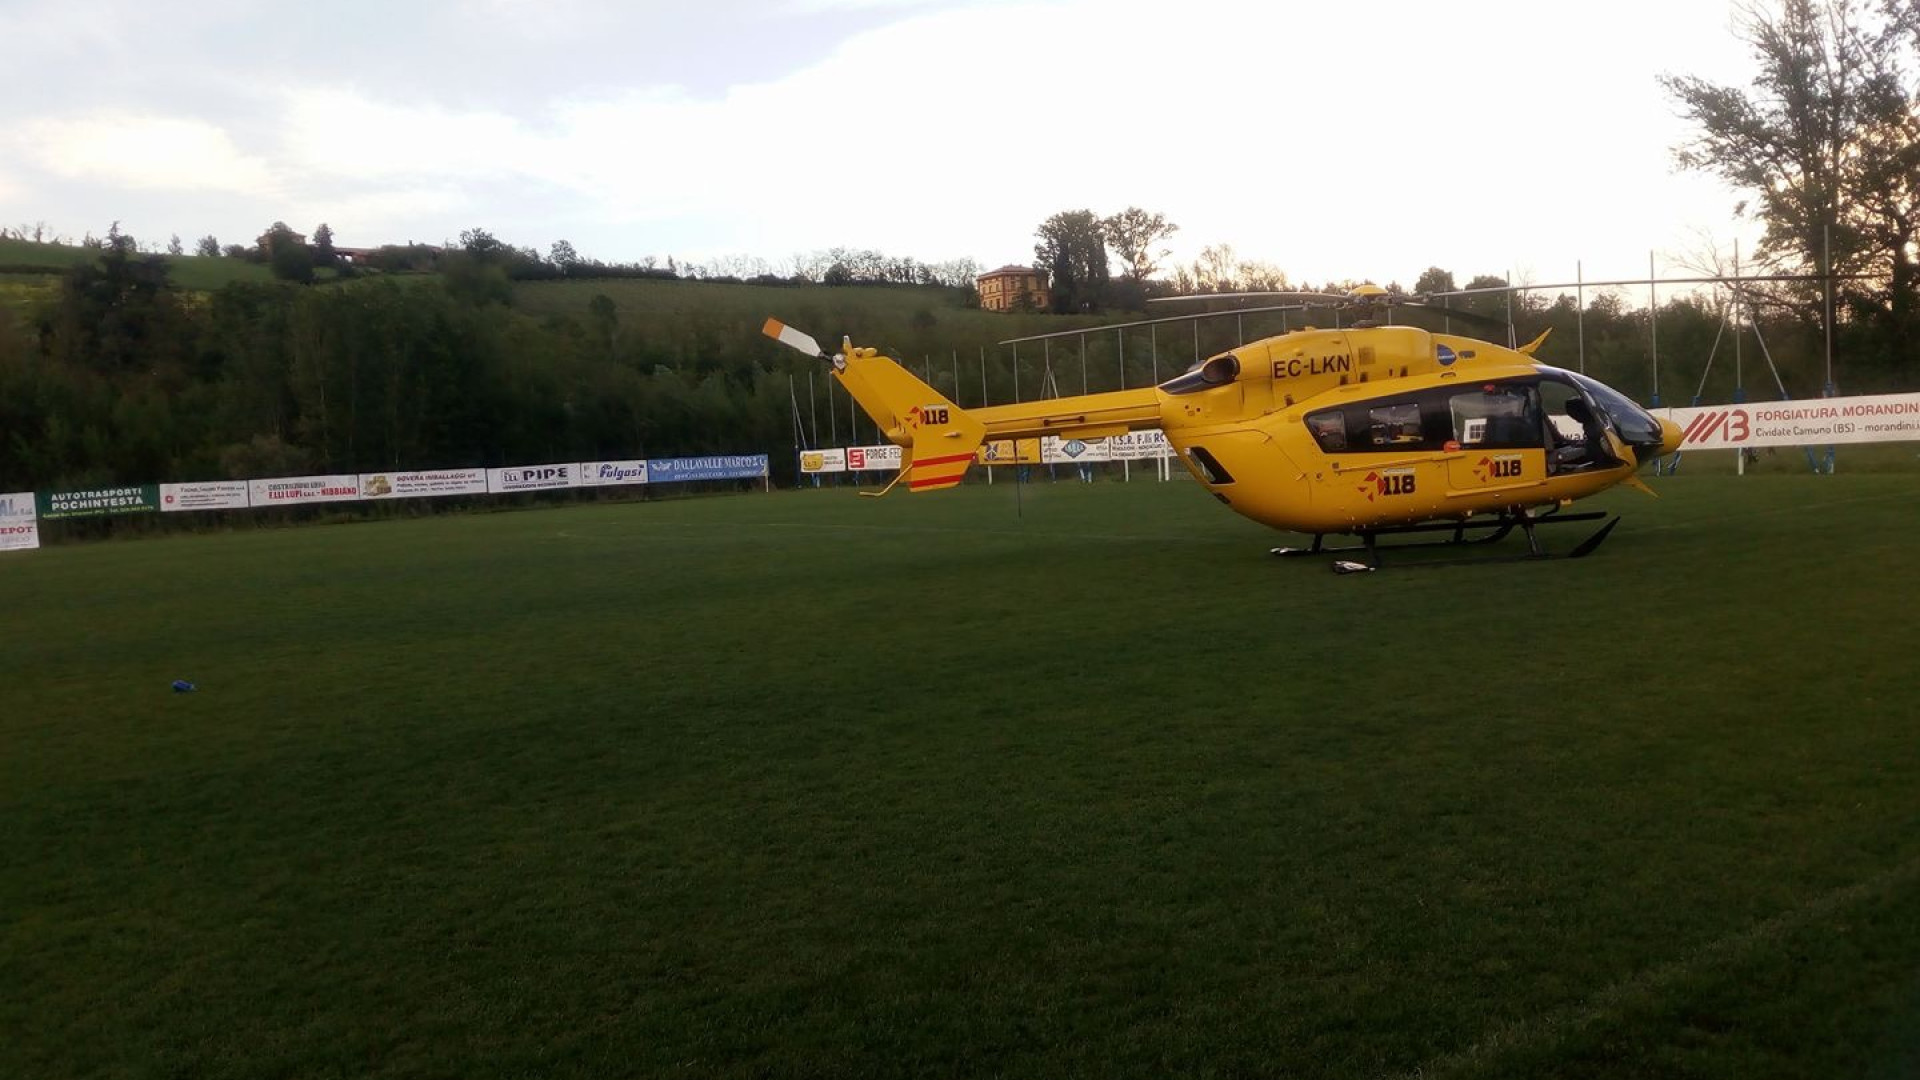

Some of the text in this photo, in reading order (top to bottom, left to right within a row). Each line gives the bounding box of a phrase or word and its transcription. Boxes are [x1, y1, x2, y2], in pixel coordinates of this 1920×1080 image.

[1273, 354, 1351, 379] EC-LKN
[924, 409, 949, 424] 118
[1755, 408, 1838, 421] FORGIATURA
[1755, 427, 1791, 437] Cividate
[1792, 424, 1831, 436] Camuno
[1833, 423, 1855, 433] (BS)
[865, 448, 887, 459] FORGE
[724, 457, 751, 468] MARCO
[1495, 460, 1522, 477] 118
[523, 467, 568, 481] PIPE
[1383, 475, 1416, 496] 118
[51, 488, 142, 501] AUTOTRASPORTI
[286, 489, 302, 498] LUPI
[51, 496, 144, 511] POCHINTESTA
